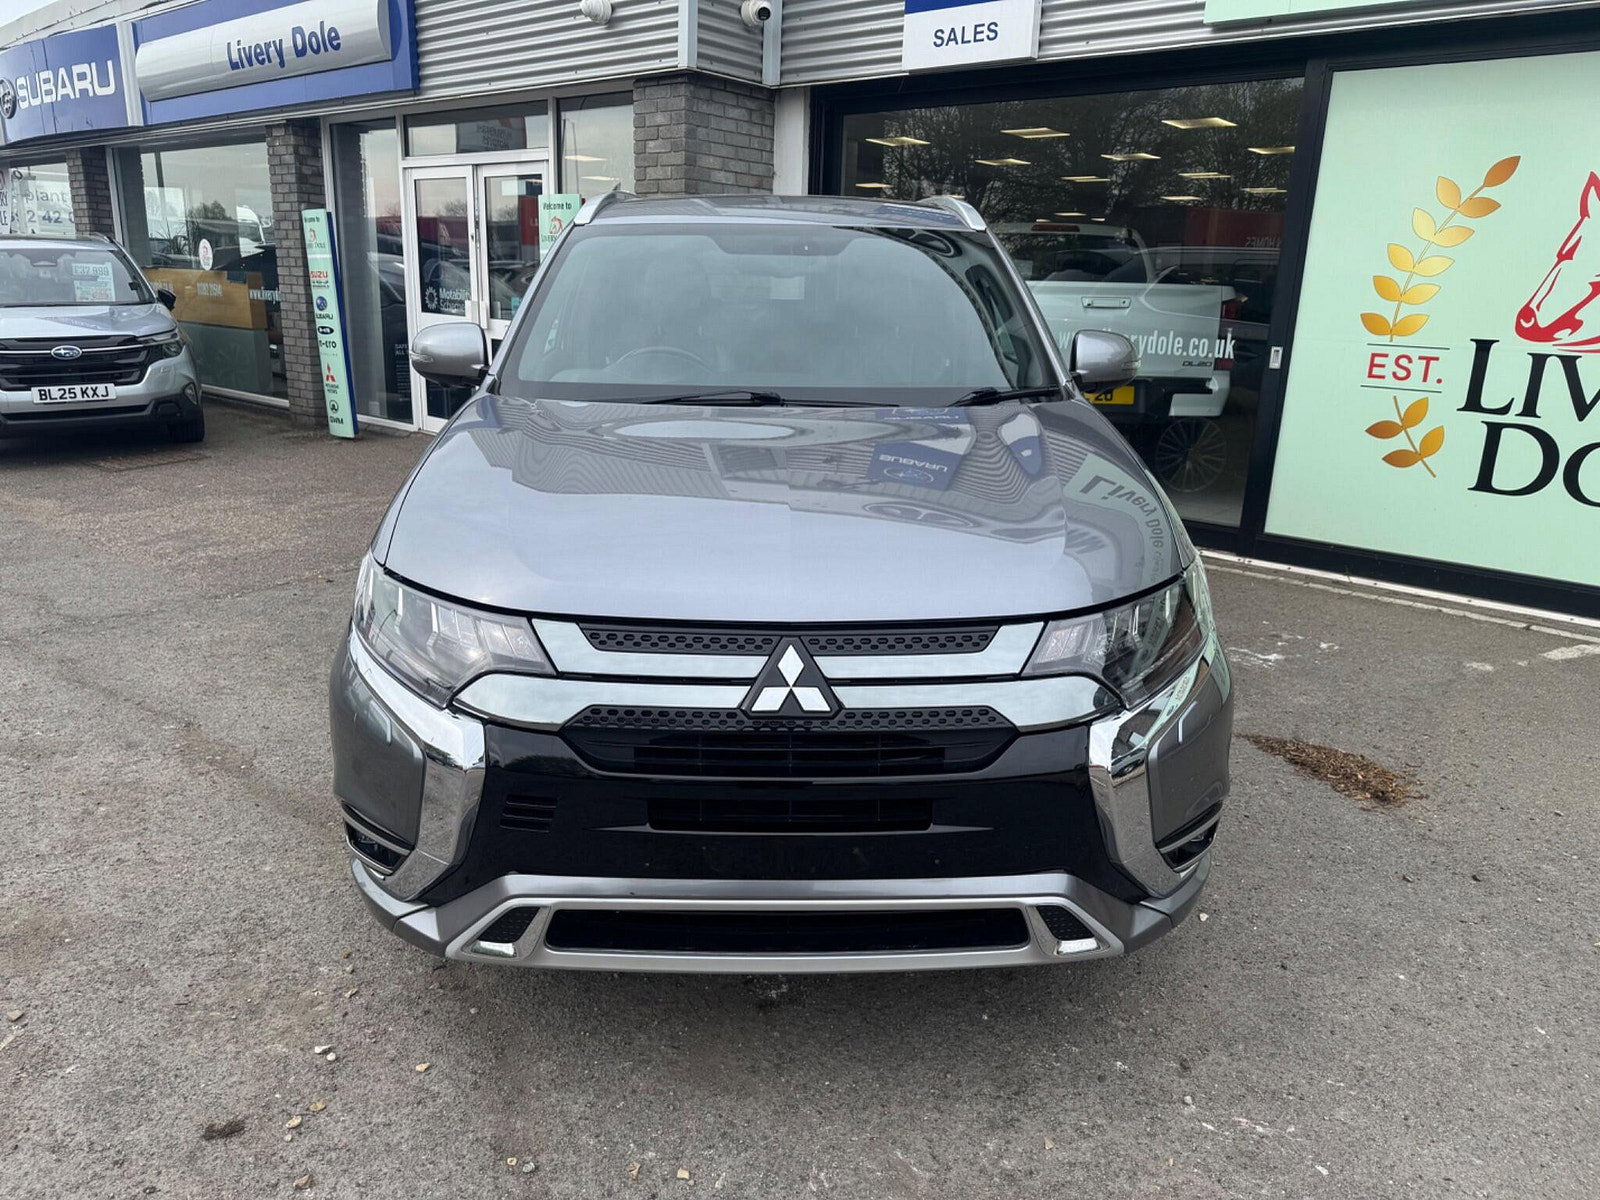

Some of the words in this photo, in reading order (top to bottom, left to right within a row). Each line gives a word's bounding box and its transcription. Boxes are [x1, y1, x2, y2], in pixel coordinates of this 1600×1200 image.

[227, 39, 286, 71] Livery
[291, 20, 342, 58] Dole
[933, 21, 999, 48] SALES
[16, 60, 116, 110] SUBARU
[565, 201, 573, 210] to
[1366, 352, 1443, 385] EST.
[38, 387, 77, 401] BL25
[80, 385, 109, 399] KXJ
